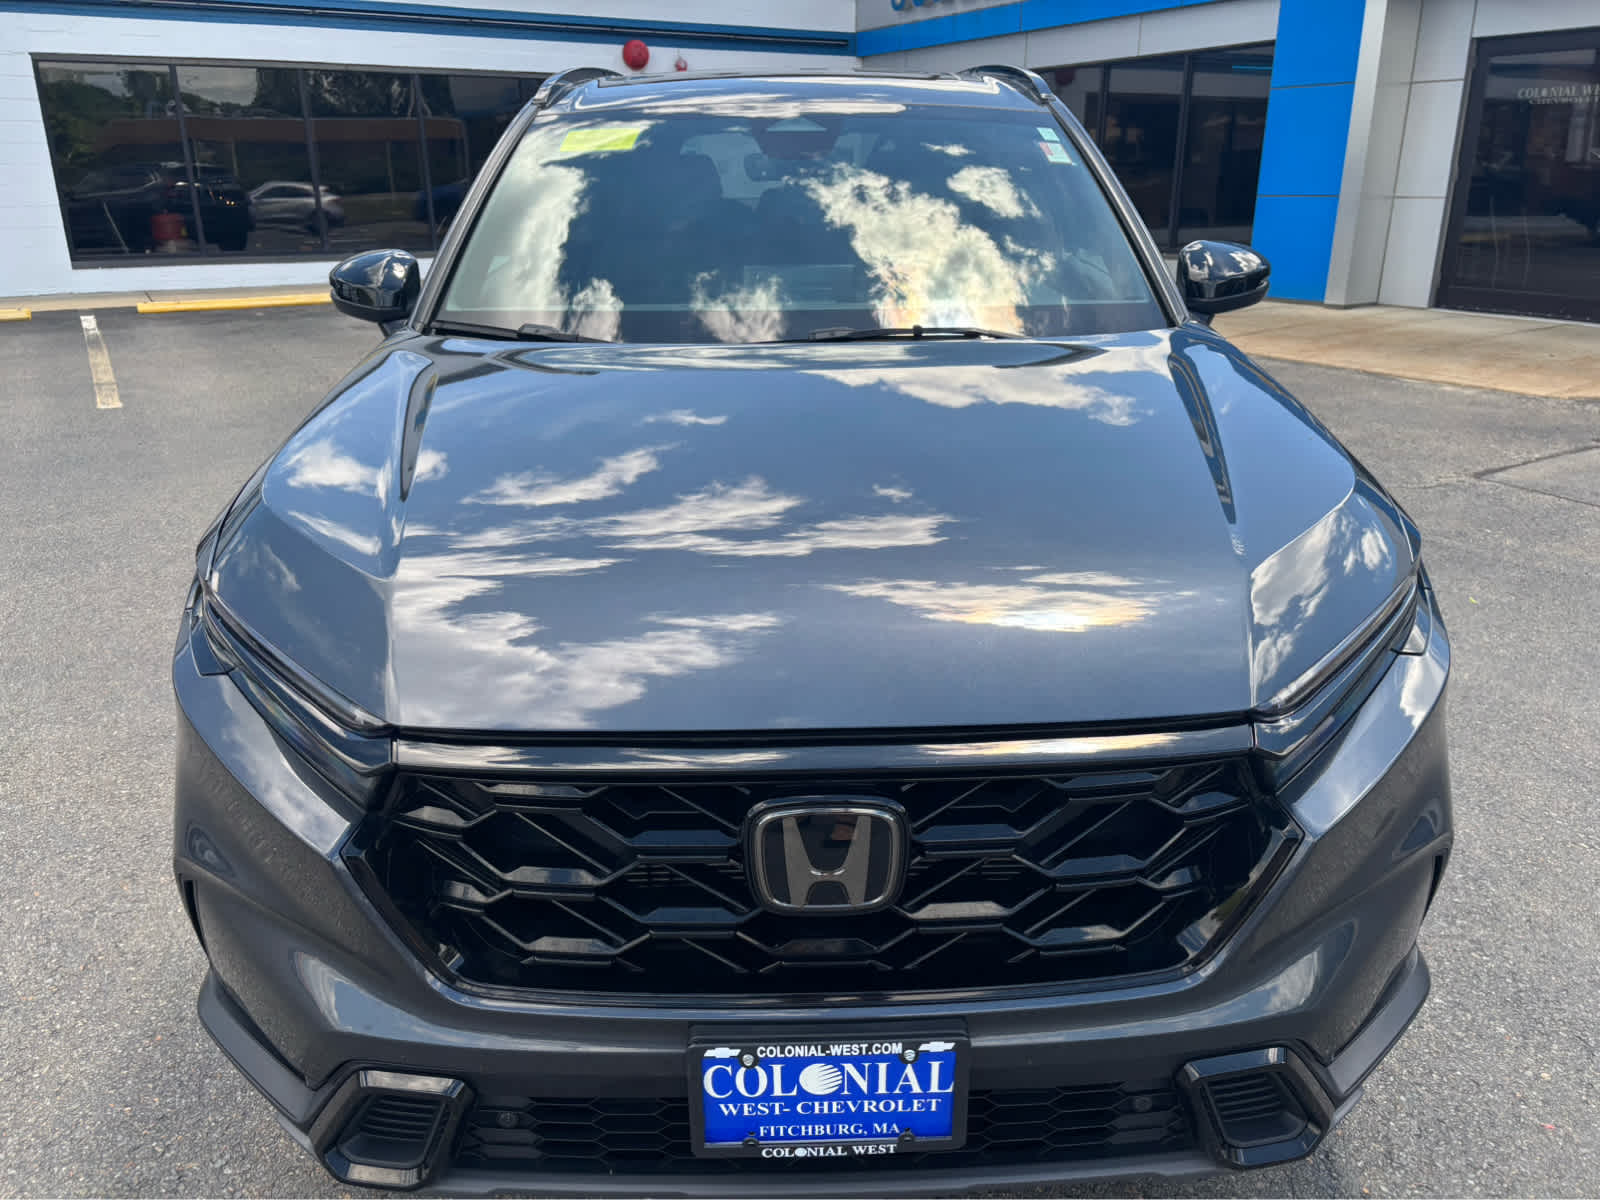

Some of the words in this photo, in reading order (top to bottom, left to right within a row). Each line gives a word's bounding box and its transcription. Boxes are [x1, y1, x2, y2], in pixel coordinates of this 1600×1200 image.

[756, 1042, 903, 1058] COLONIAL-WEST.COM
[703, 1060, 955, 1099] COLONIAL
[796, 1098, 942, 1116] CHEVROLET
[759, 1122, 868, 1137] FITCHBURG,
[873, 1122, 900, 1135] MA
[761, 1145, 848, 1159] COLONIAL
[852, 1143, 897, 1156] WEST
